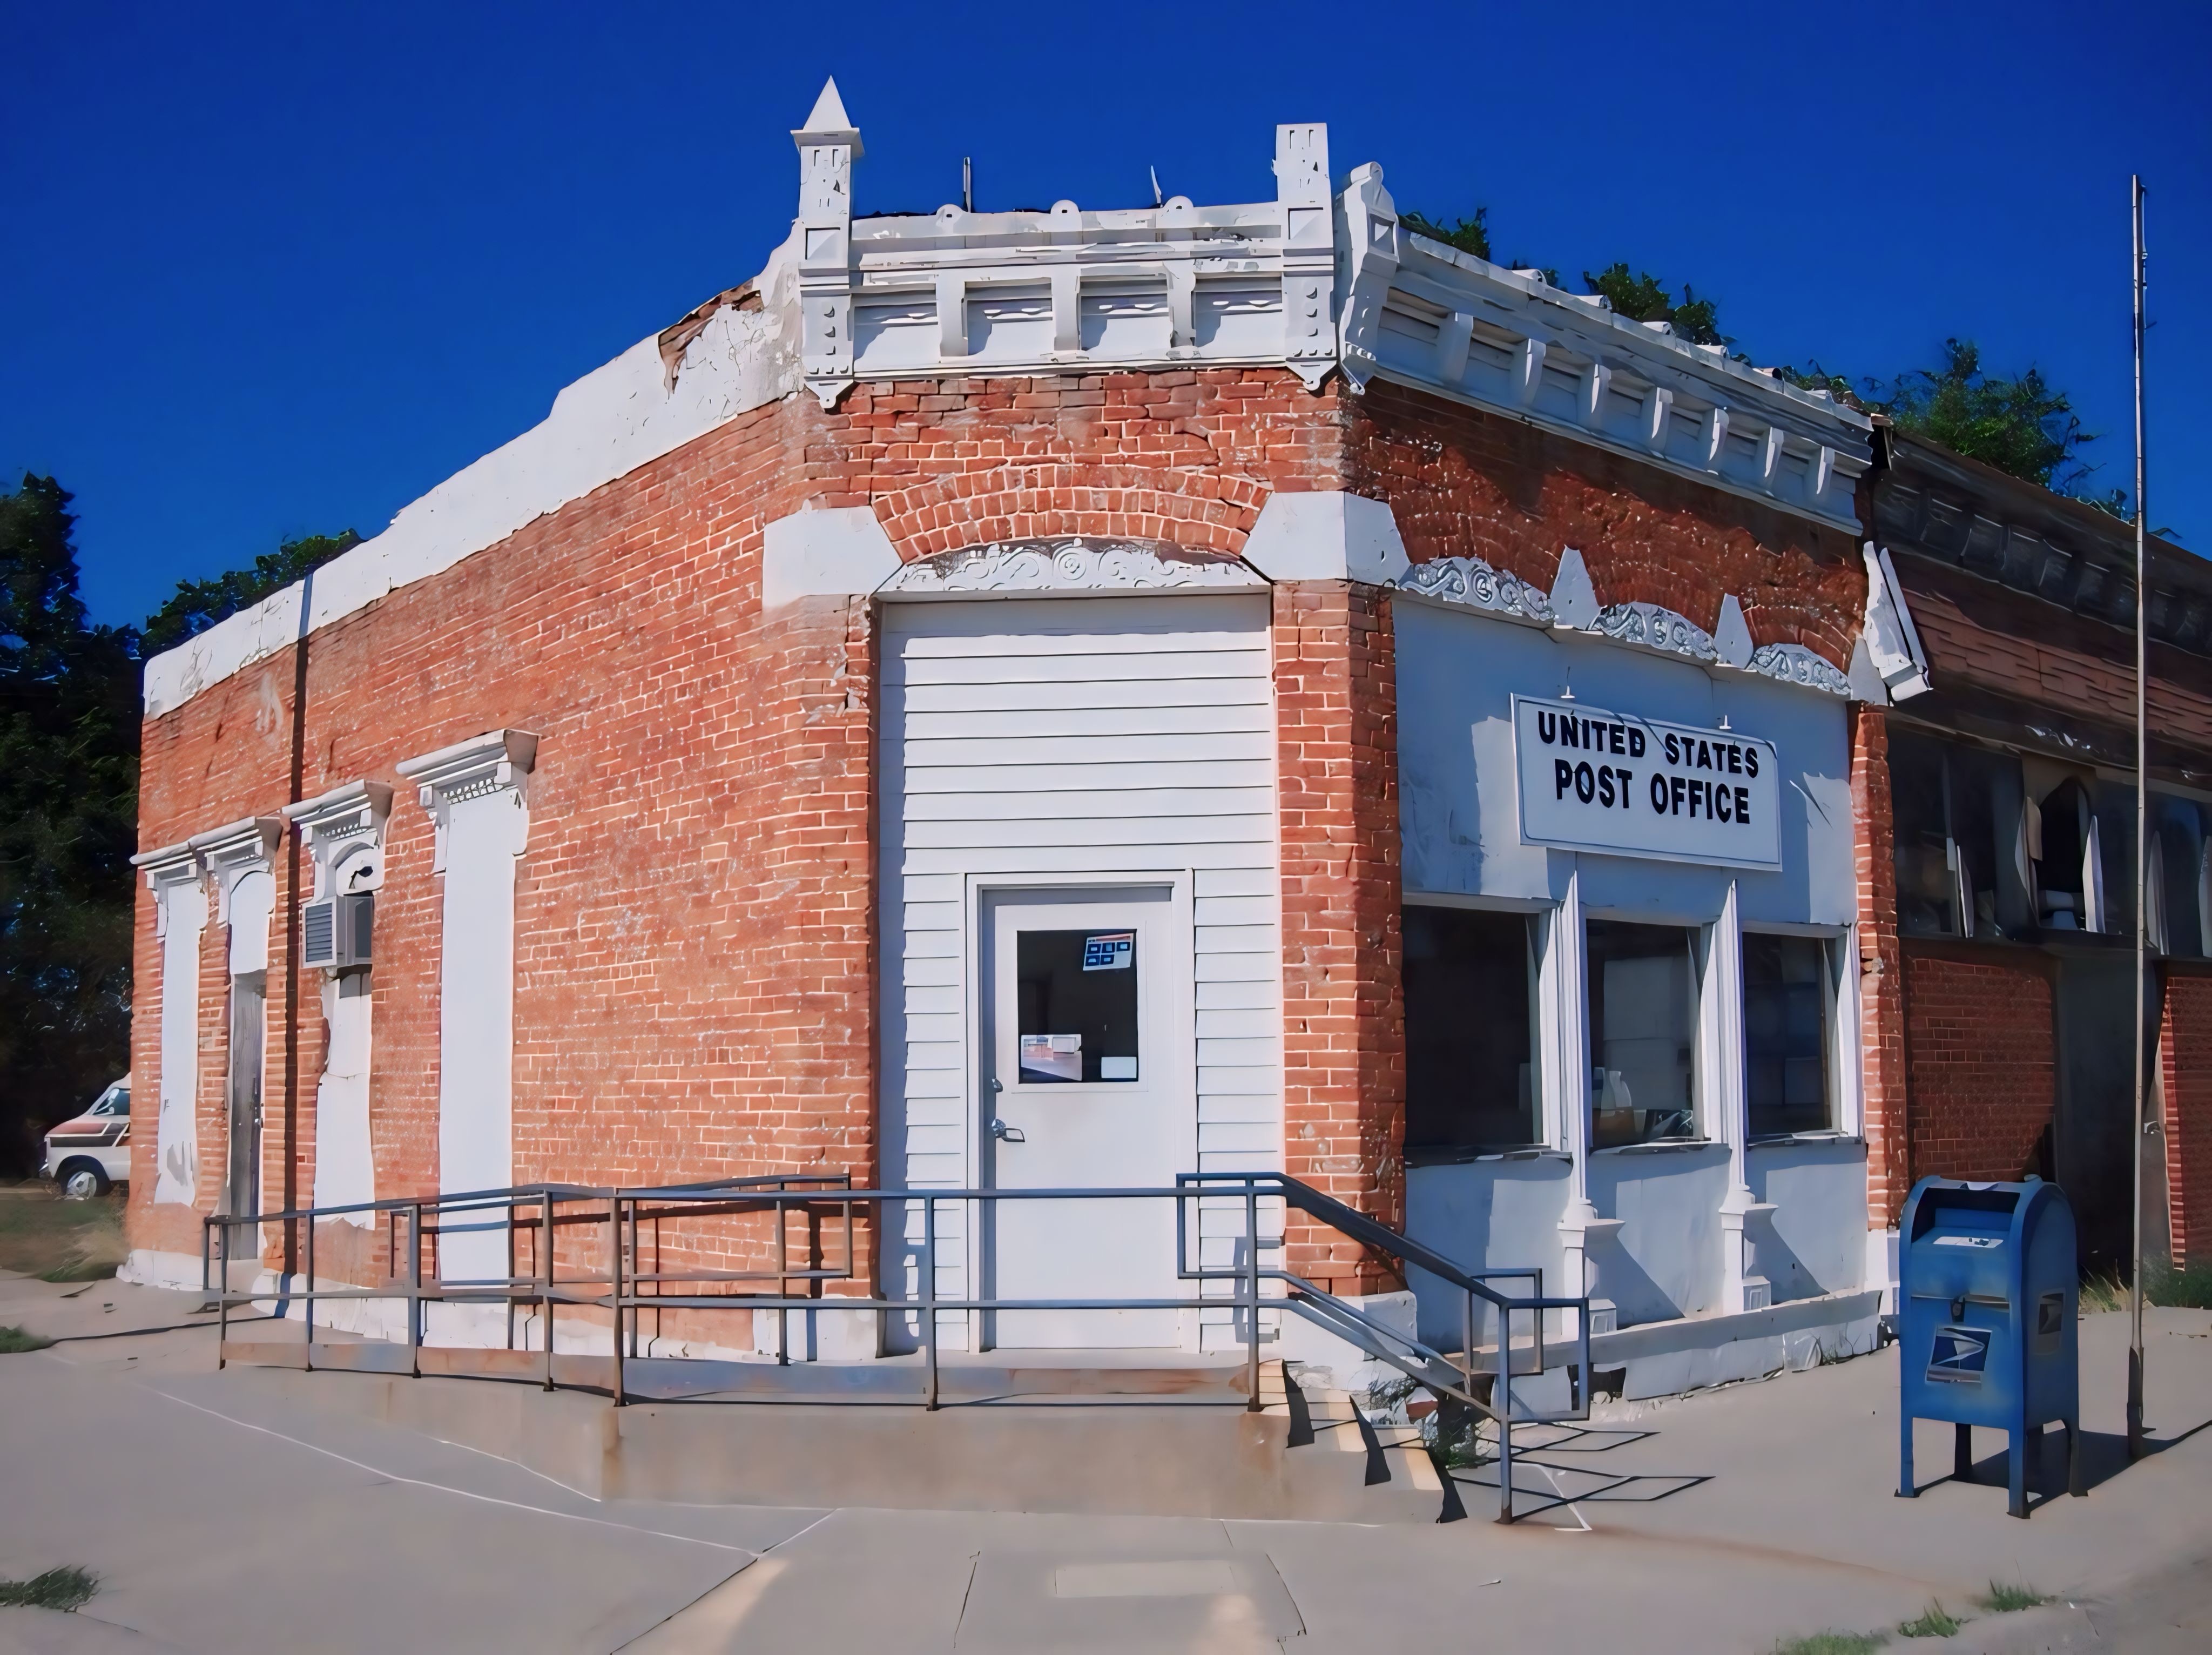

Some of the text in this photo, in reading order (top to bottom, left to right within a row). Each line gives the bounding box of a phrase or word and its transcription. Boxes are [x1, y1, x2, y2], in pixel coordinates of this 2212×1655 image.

[1538, 711, 1758, 778] UNITED STATES
[1555, 759, 1750, 824] POST OFFICE
